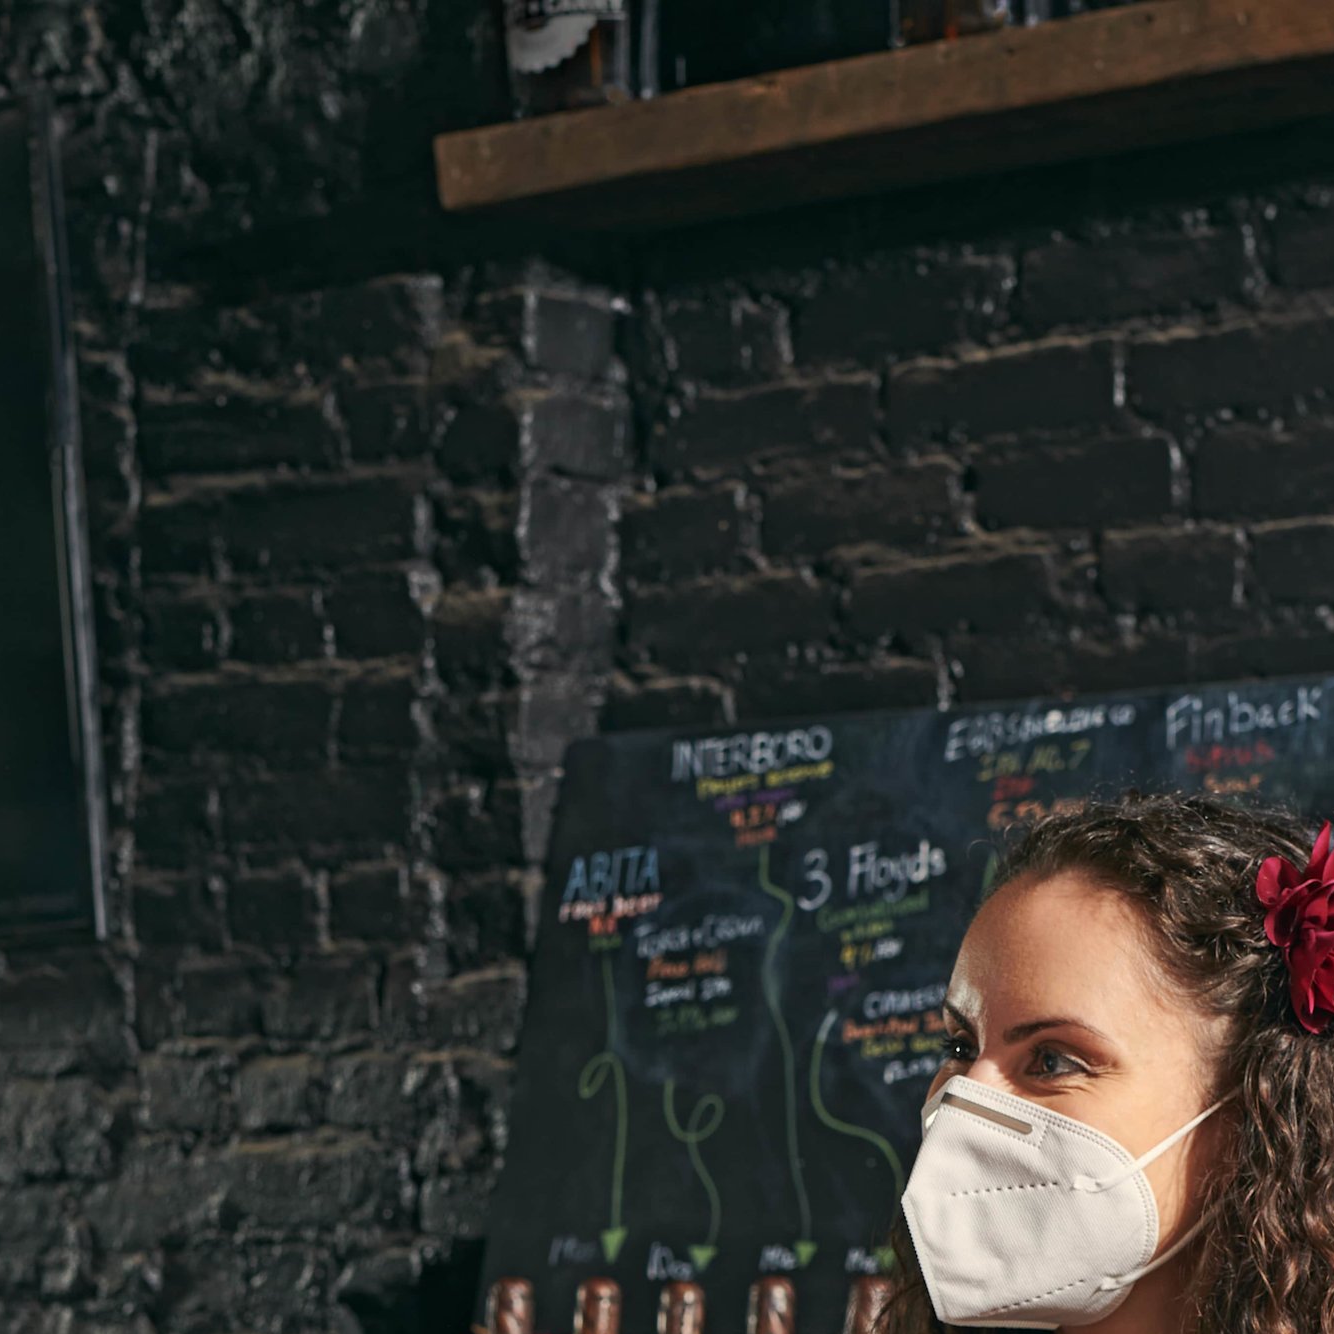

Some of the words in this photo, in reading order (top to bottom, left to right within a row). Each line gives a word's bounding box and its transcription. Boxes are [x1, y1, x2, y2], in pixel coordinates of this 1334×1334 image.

[1166, 686, 1323, 750] Finback
[670, 724, 834, 783] INTERBORO
[562, 845, 662, 904] ABITA
[796, 847, 834, 913] 3
[847, 838, 948, 904] Floyds
